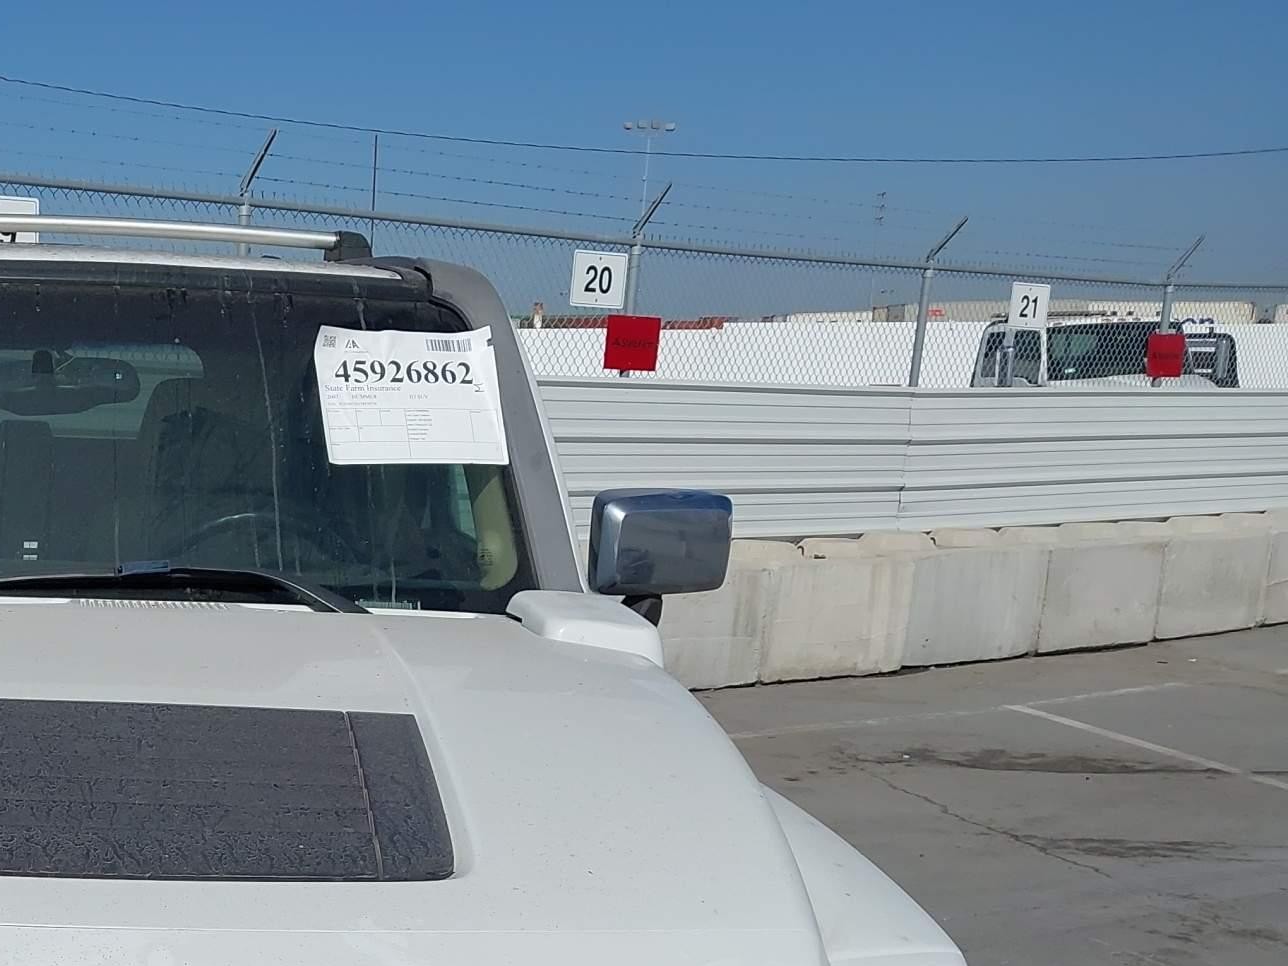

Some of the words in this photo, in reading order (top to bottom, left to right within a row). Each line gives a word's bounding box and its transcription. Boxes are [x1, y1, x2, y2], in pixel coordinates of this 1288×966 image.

[584, 265, 612, 294] 20
[1019, 295, 1039, 318] 21
[335, 359, 473, 385] 45926862
